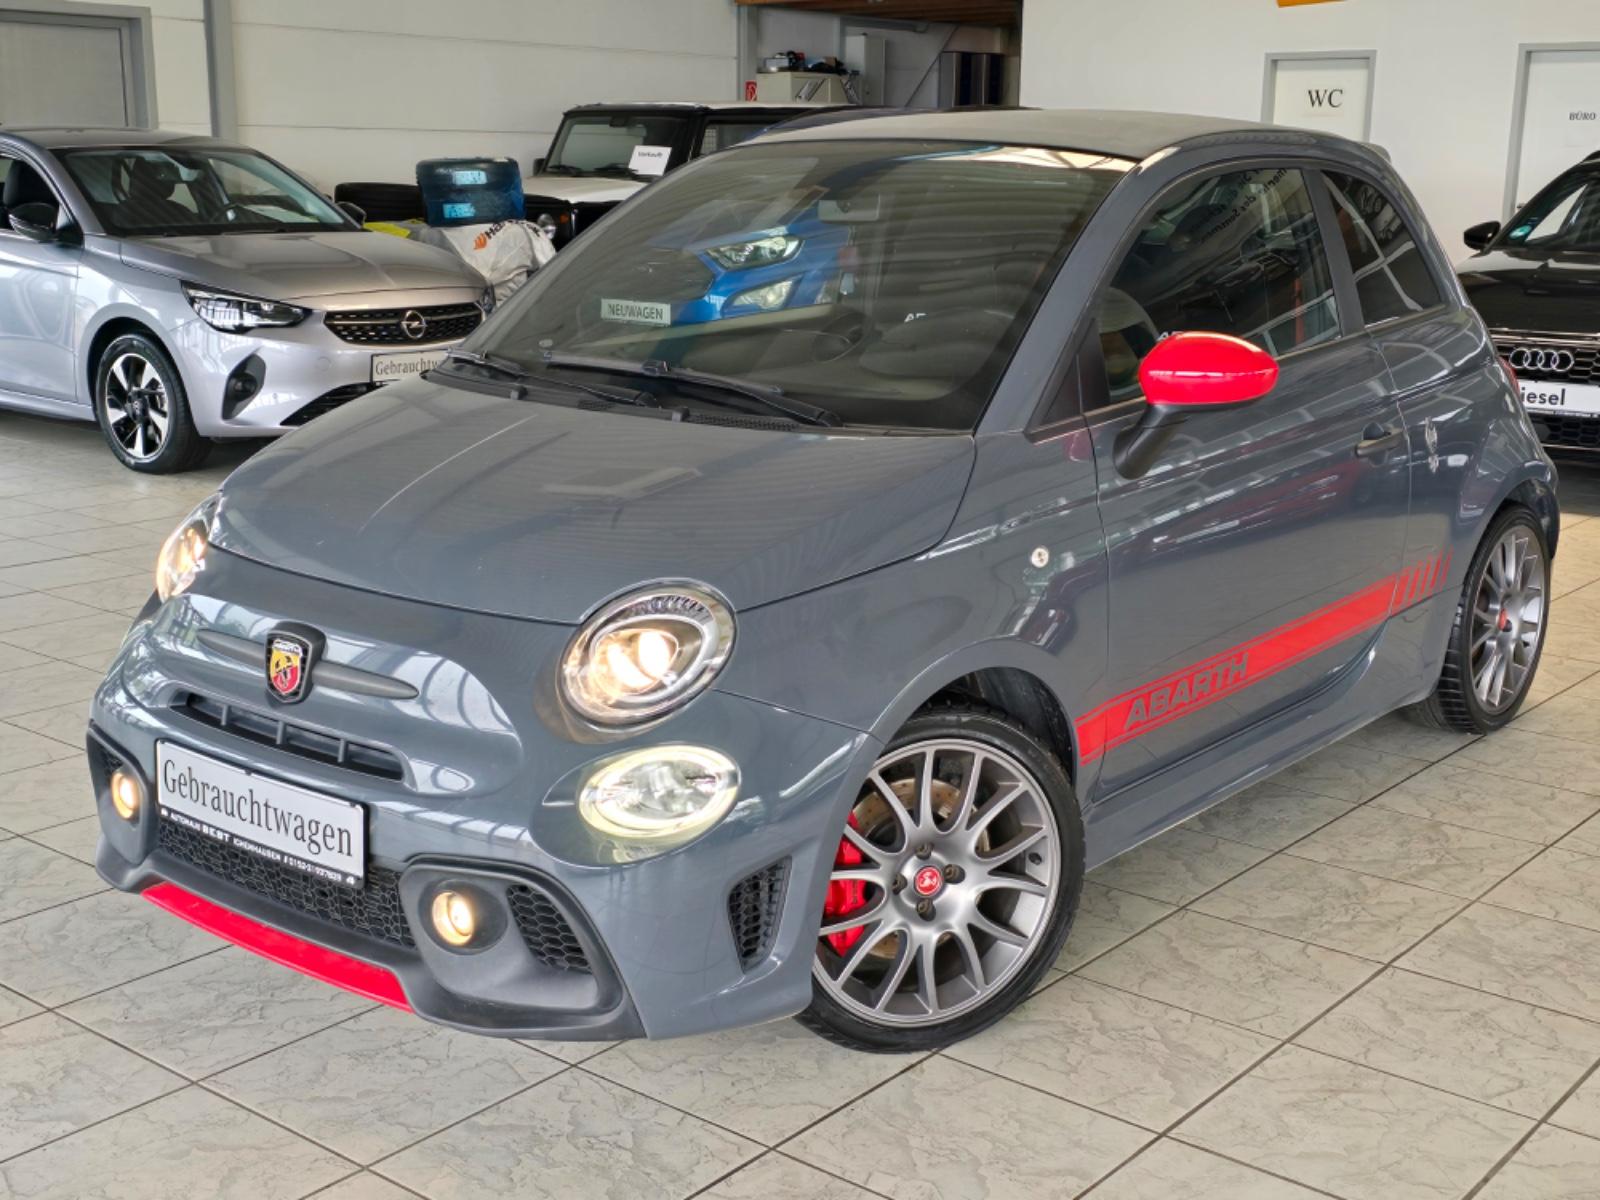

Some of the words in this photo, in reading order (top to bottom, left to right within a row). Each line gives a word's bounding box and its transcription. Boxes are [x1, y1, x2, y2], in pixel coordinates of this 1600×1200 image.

[1308, 89, 1343, 108] WC
[607, 303, 664, 320] NEUWAGEN
[1520, 386, 1566, 406] iesel
[1123, 651, 1249, 731] ABARTH
[164, 758, 352, 857] Gebrauchtwagen
